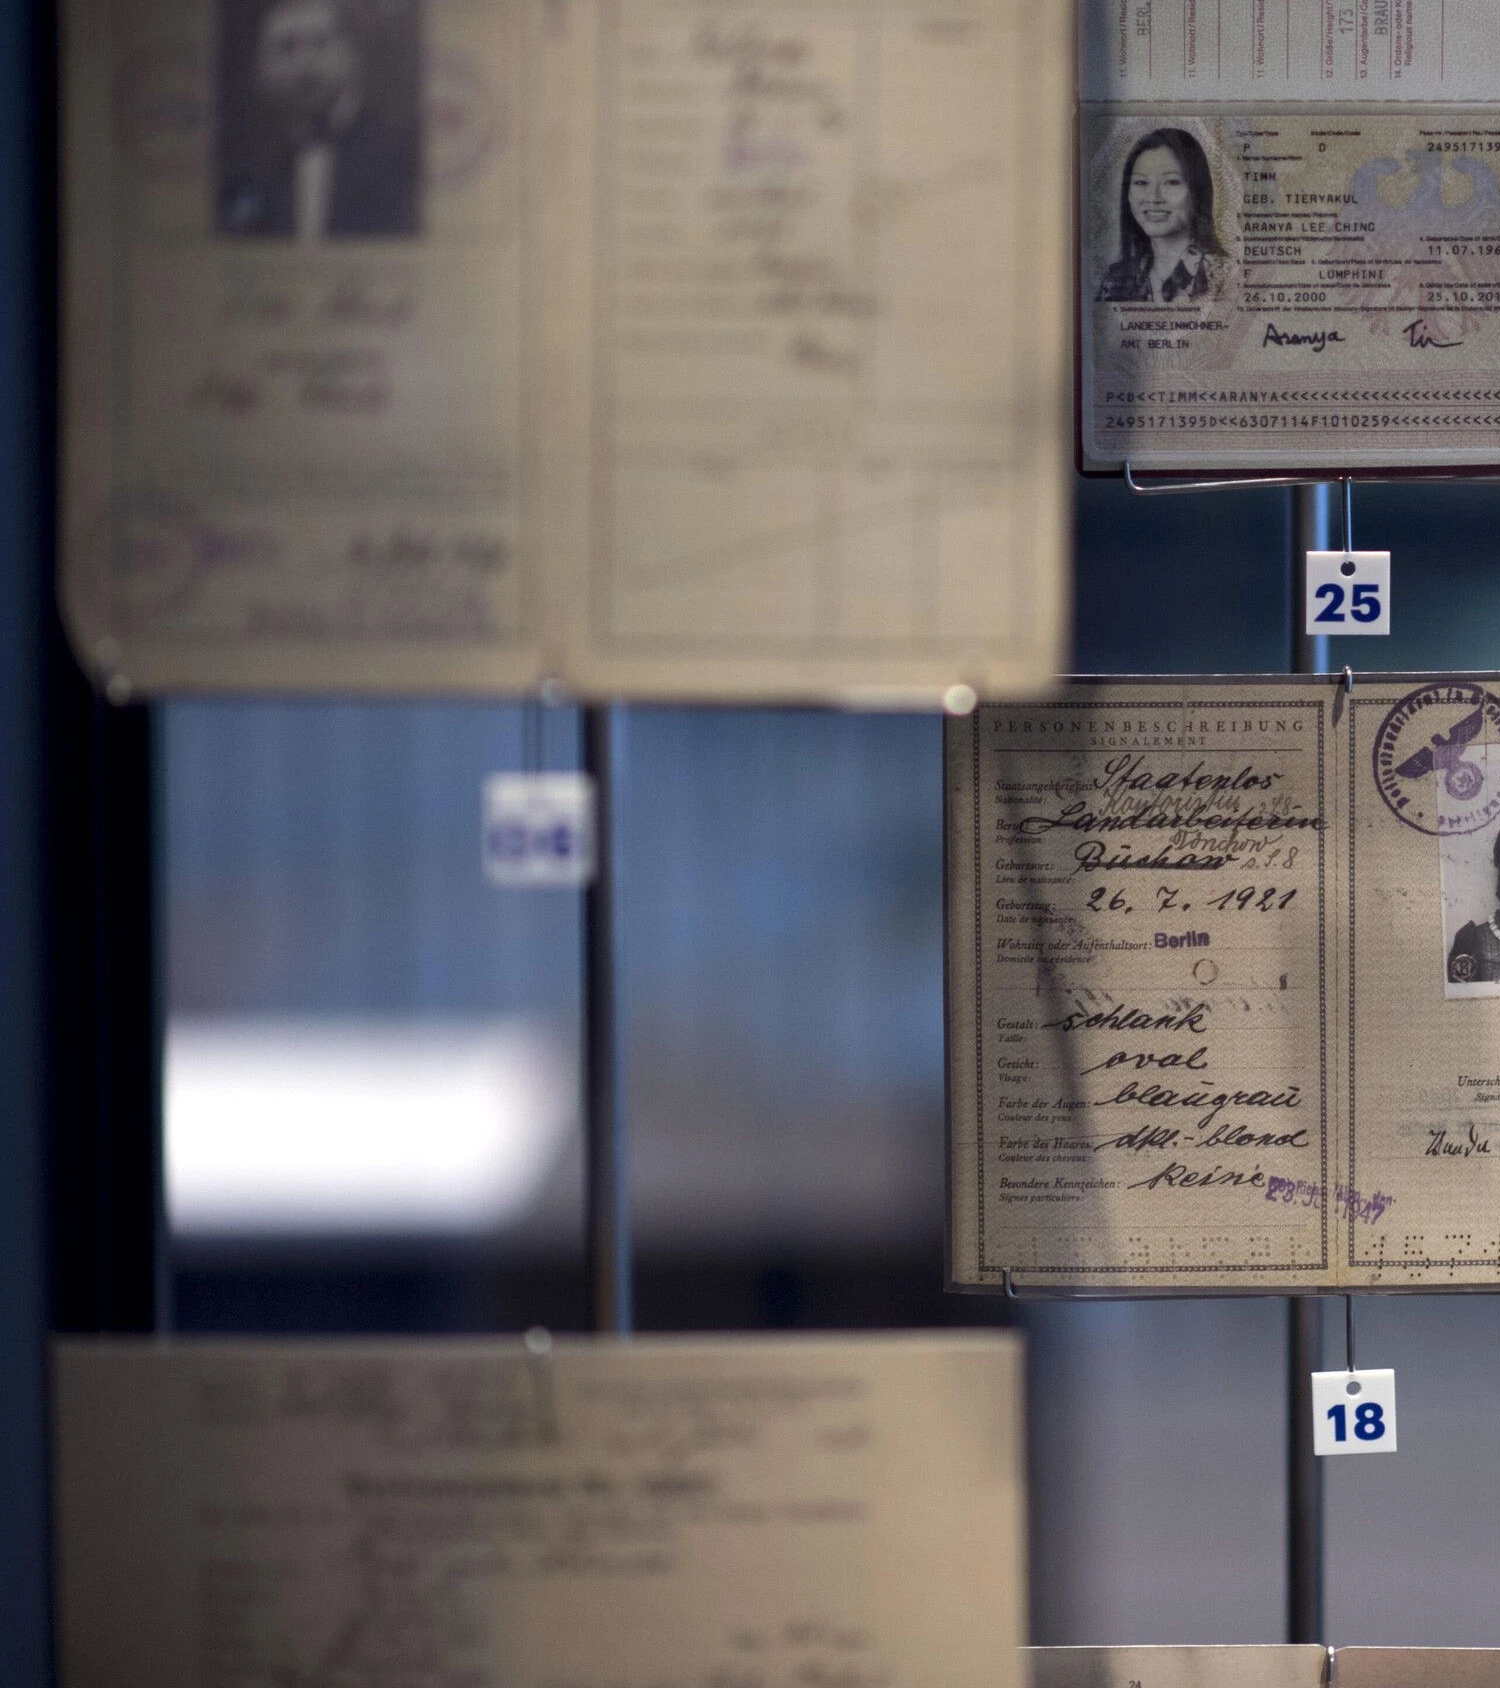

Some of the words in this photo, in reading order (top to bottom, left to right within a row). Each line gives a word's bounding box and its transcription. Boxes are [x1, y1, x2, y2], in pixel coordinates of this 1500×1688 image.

[1339, 9, 1354, 34] 173
[1375, 0, 1388, 35] BRAU
[1243, 142, 1251, 153] P
[1318, 142, 1327, 153] D
[1244, 172, 1277, 182] TIMM
[1243, 194, 1275, 204] GEB.
[1286, 194, 1359, 204] TIERYAKUL
[1244, 222, 1293, 232] ARANYA
[1302, 222, 1326, 232] LEE
[1335, 222, 1376, 232] CHING
[1244, 246, 1302, 256] DEUTSCH
[1243, 269, 1251, 279] F
[1319, 269, 1384, 280] LUMPHINI
[1244, 292, 1326, 302] 26.10.2000
[1120, 321, 1229, 331] LANDESEINWOHNER-
[1120, 340, 1141, 349] AMT
[1148, 340, 1189, 349] BERLIN
[1314, 583, 1382, 622] 25
[994, 720, 1304, 733] PERSONENBESCHREIBUNG
[1090, 736, 1208, 746] SIGNALEMENT
[1093, 753, 1285, 791] Staatenlos
[1086, 887, 1133, 914] 26.
[1156, 886, 1191, 912] 7.
[1207, 886, 1298, 912] 1921
[1153, 930, 1210, 949] Berlin
[1080, 1046, 1208, 1075] oval
[998, 1096, 1028, 1109] Farbe
[1031, 1098, 1049, 1109] der
[999, 1136, 1028, 1149] Farbe
[999, 1177, 1049, 1189] Besondere
[1053, 1177, 1120, 1192] Kennzeichen:
[1327, 1402, 1386, 1442] 18
